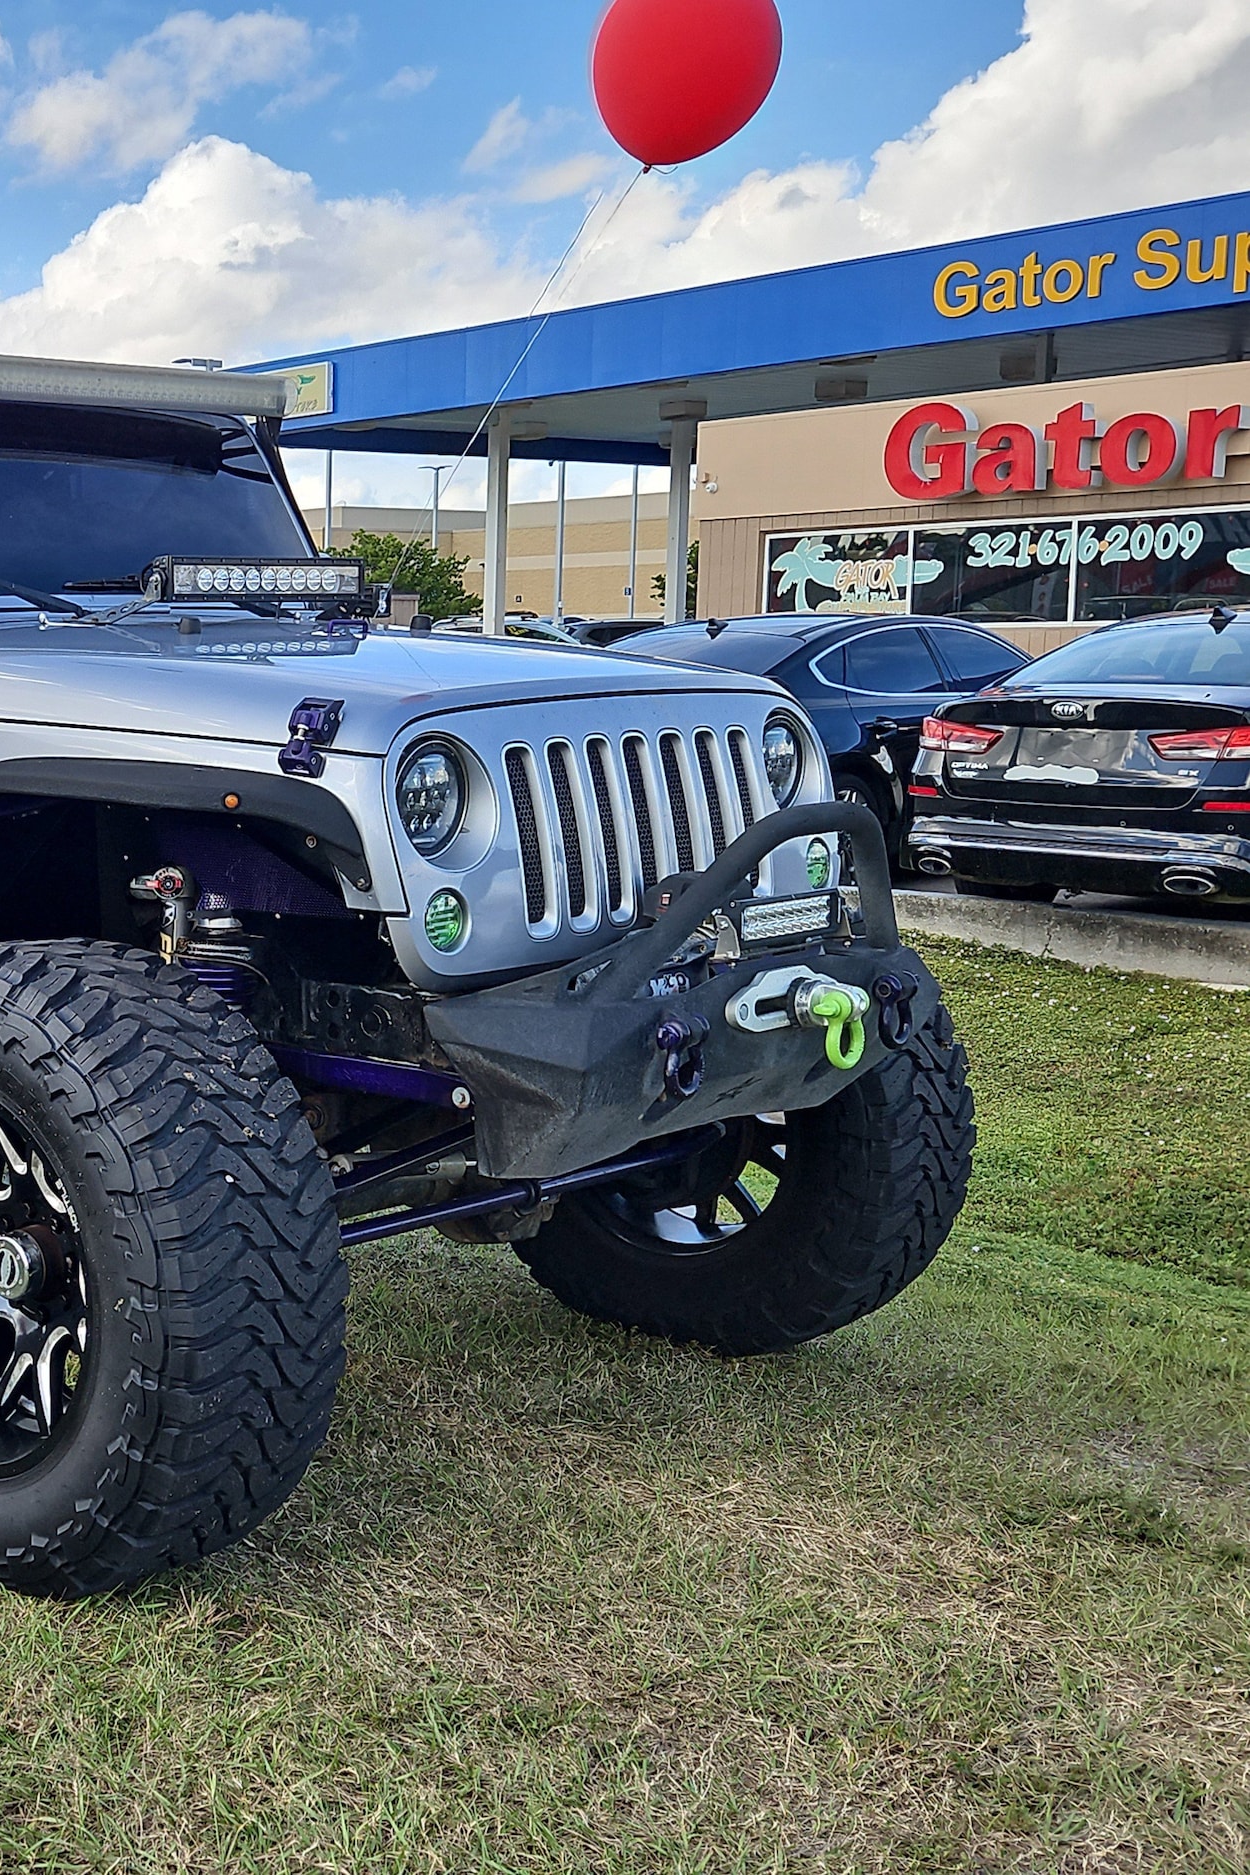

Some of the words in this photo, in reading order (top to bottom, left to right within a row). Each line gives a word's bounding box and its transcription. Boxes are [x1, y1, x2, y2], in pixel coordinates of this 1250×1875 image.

[932, 250, 1117, 318] Gator
[884, 401, 1247, 501] Gator
[834, 560, 899, 599] GATOR
[951, 761, 989, 770] OPTIMA
